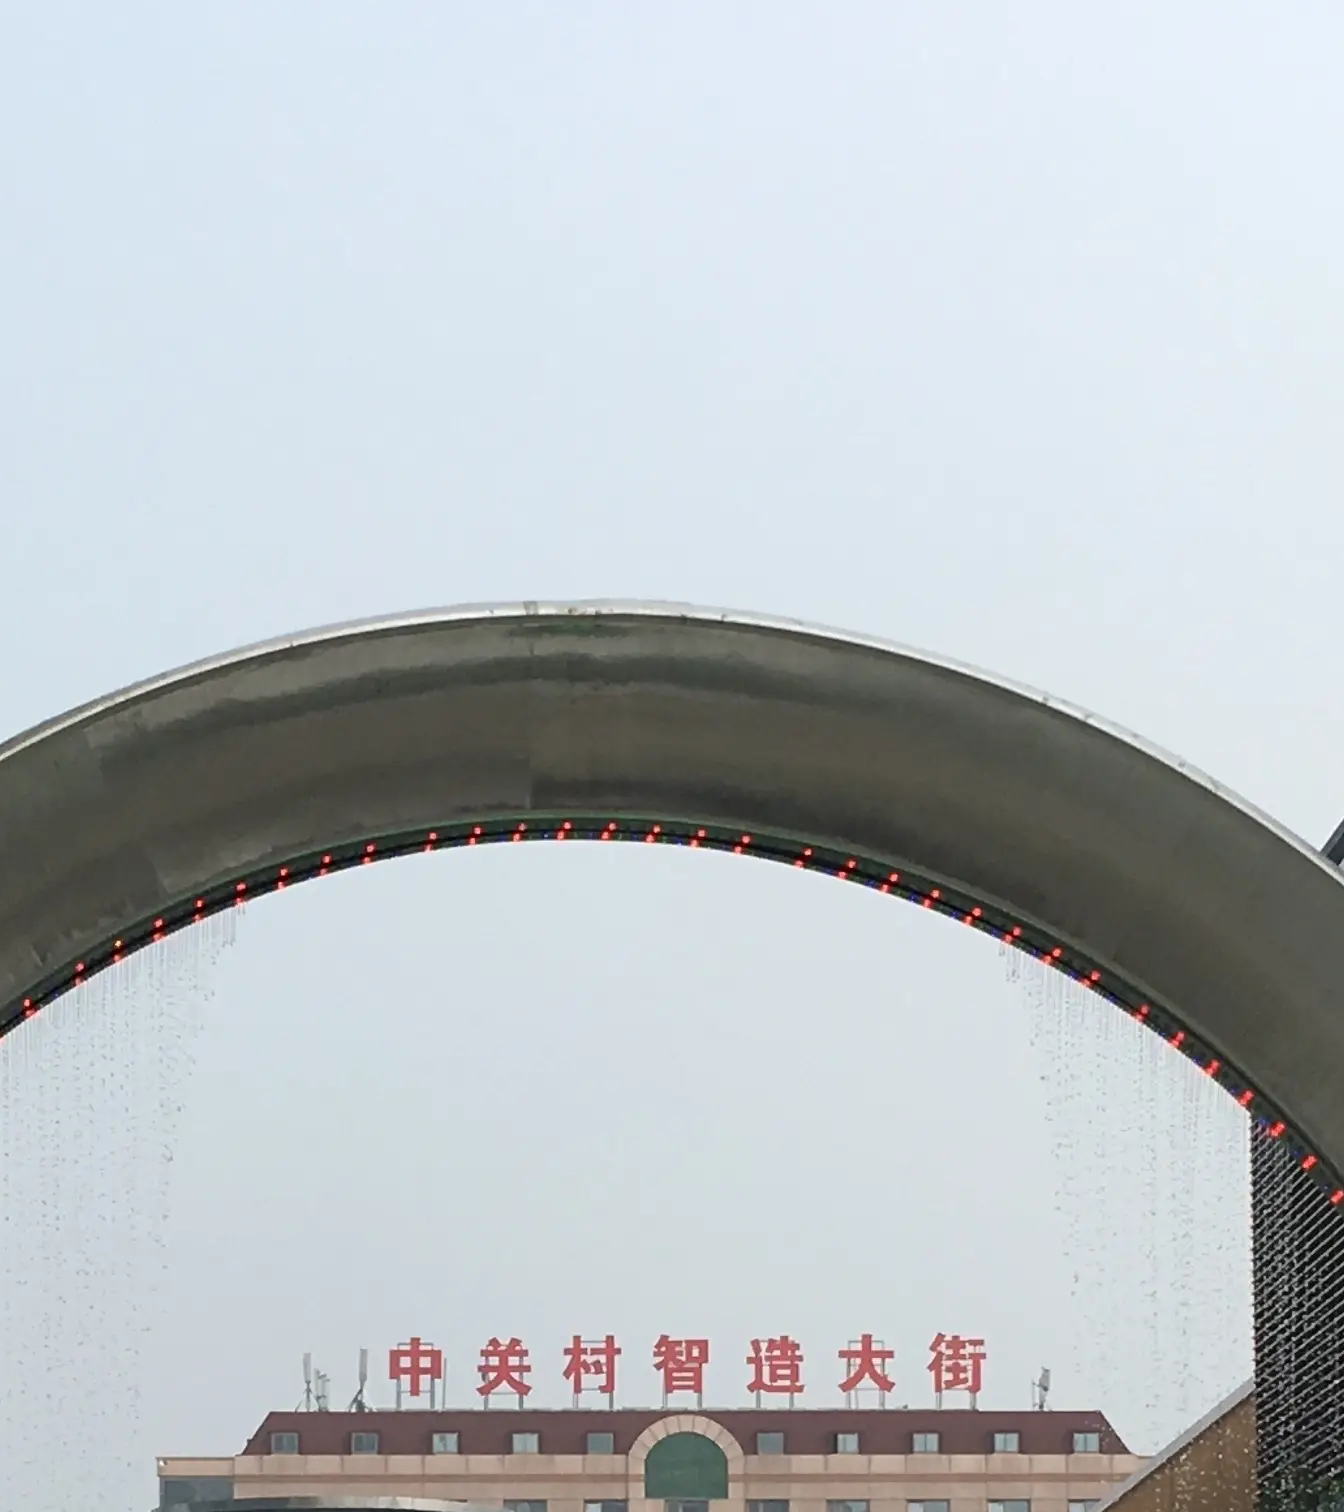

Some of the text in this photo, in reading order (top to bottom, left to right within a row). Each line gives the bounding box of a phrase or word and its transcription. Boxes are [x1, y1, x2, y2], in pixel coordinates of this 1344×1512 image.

[388, 1332, 987, 1396] 中关村智造大街
